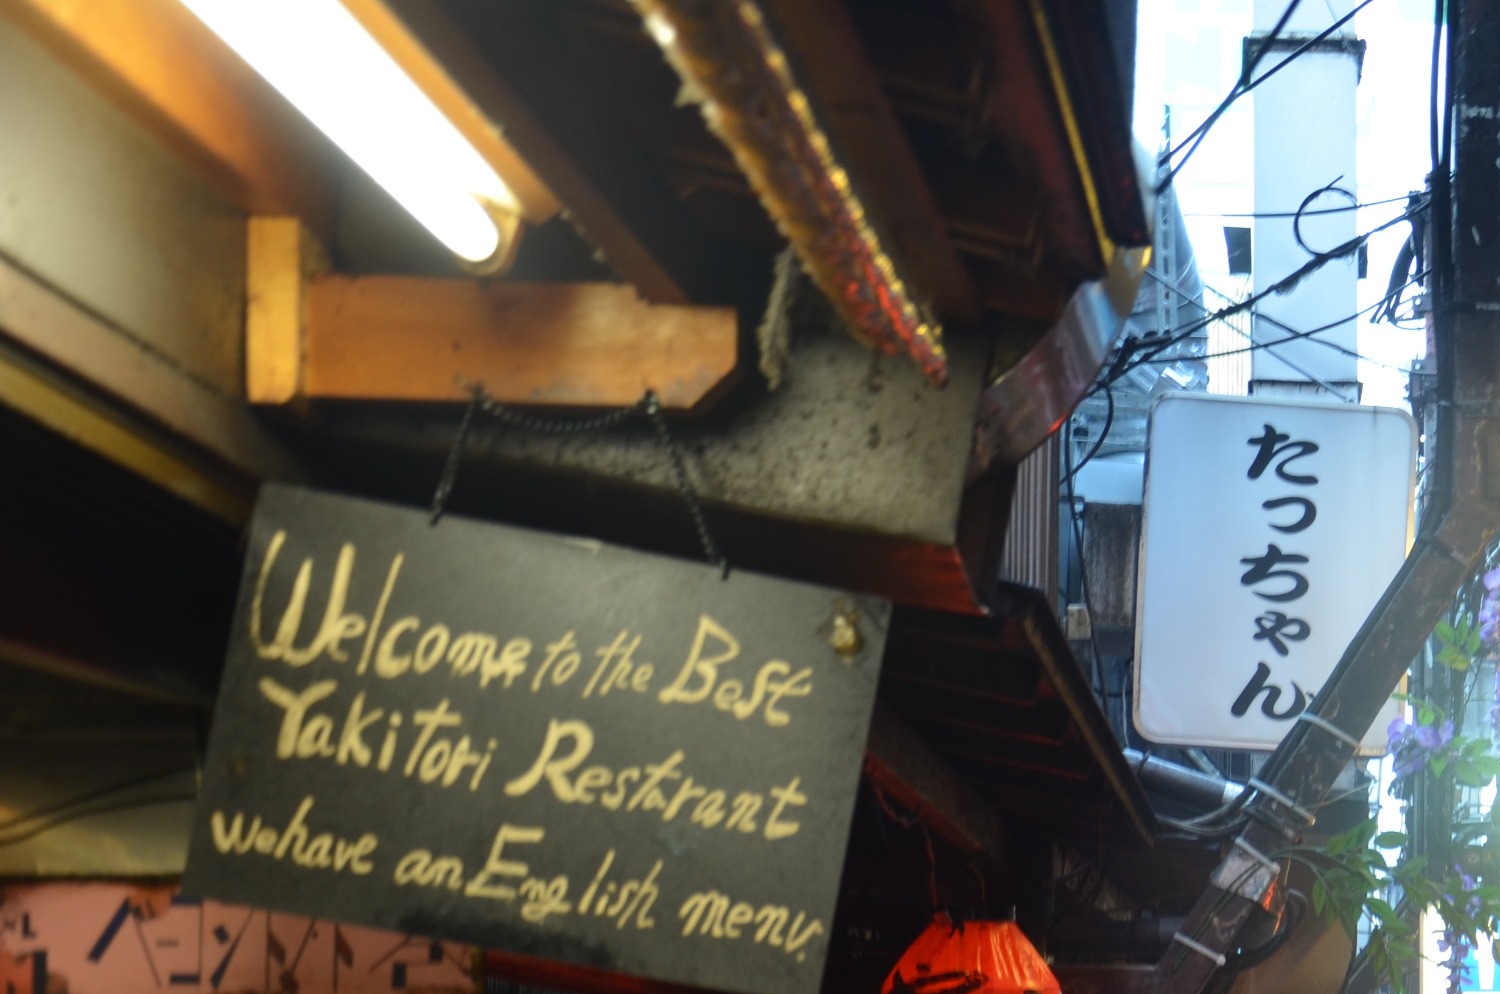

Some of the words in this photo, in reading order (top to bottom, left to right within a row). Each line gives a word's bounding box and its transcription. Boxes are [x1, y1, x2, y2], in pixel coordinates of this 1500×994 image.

[250, 529, 532, 689] Welcome
[530, 631, 580, 693] to
[577, 628, 650, 701] the
[660, 615, 813, 727] Best
[1230, 424, 1320, 721] たっちゃん
[259, 677, 497, 792] Yakitori
[396, 849, 466, 892] an
